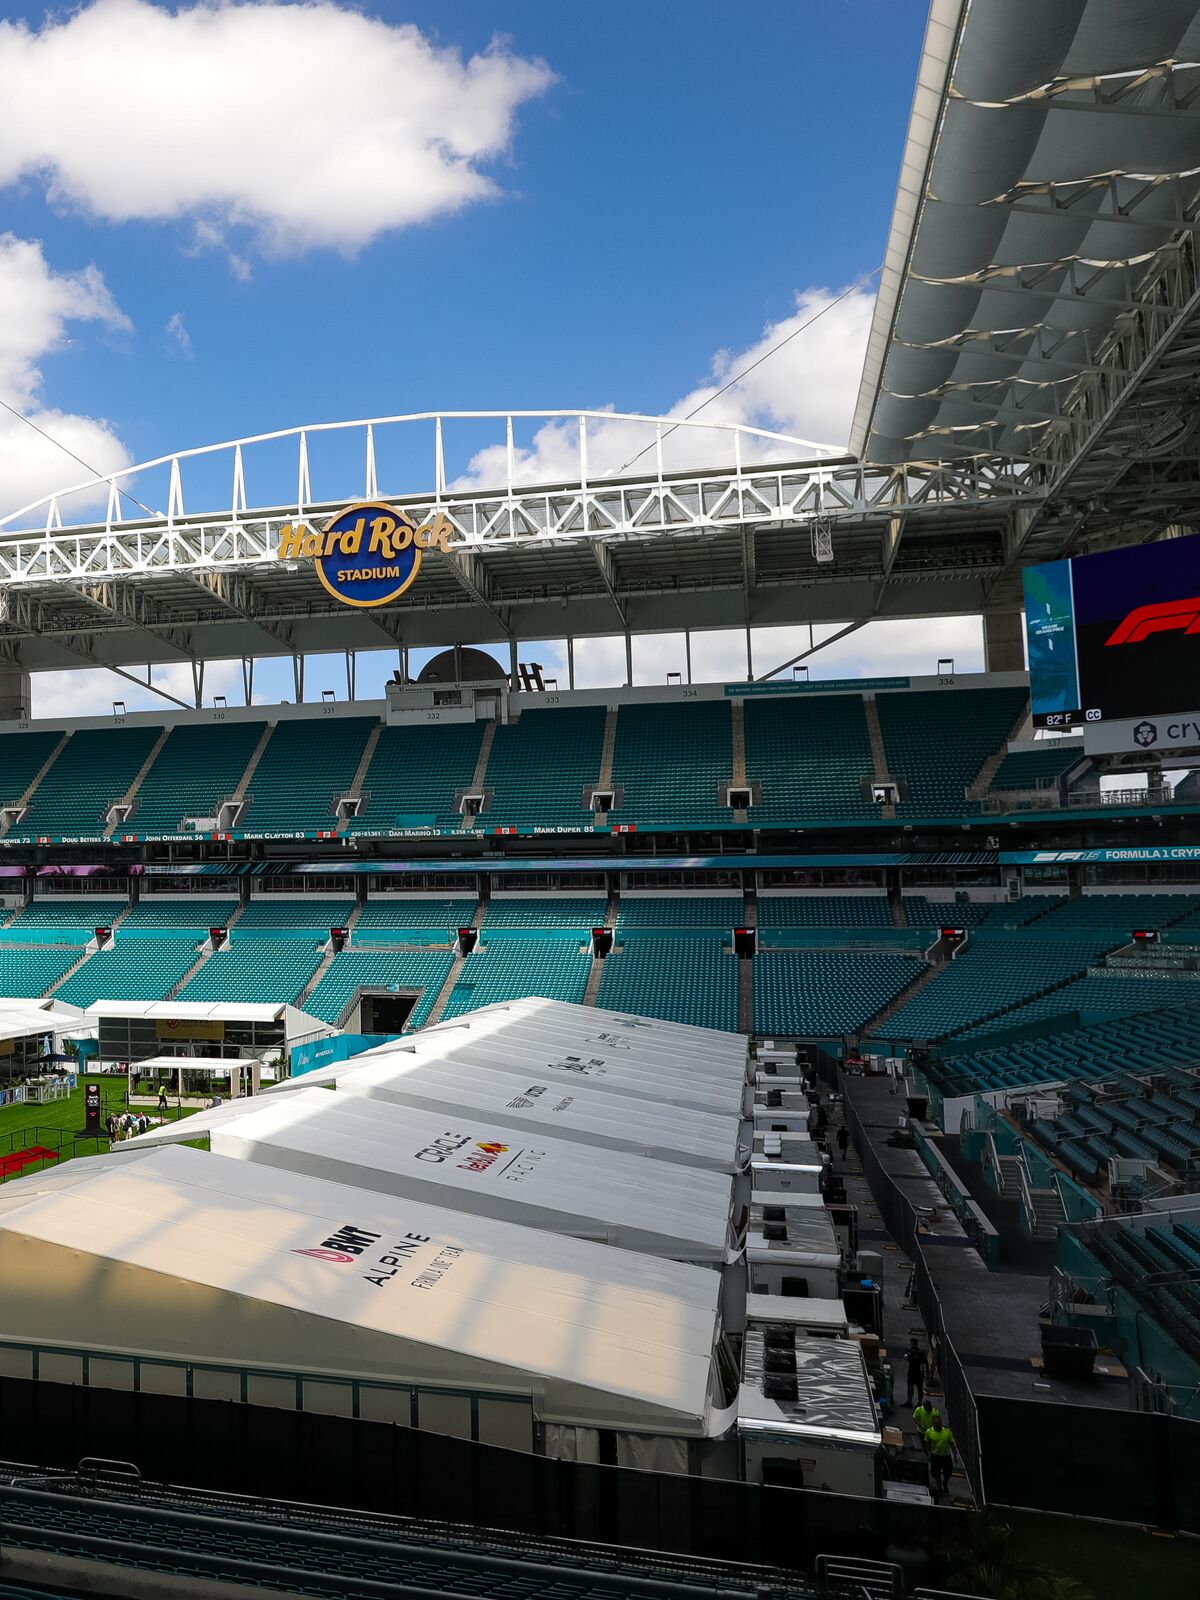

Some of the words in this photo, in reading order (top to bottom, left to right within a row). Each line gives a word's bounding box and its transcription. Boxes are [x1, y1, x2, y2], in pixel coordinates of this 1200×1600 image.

[278, 518, 366, 559] Hard
[369, 512, 454, 559] Rock
[337, 566, 400, 582] STADIUM
[323, 707, 335, 715] 331
[426, 712, 440, 720] 332
[1065, 714, 1072, 724] F
[404, 829, 431, 837] MARINO
[1105, 849, 1161, 860] FORMULA
[1162, 849, 1169, 858] 1
[320, 1225, 382, 1256] BWT
[362, 1232, 432, 1288] ALPINE
